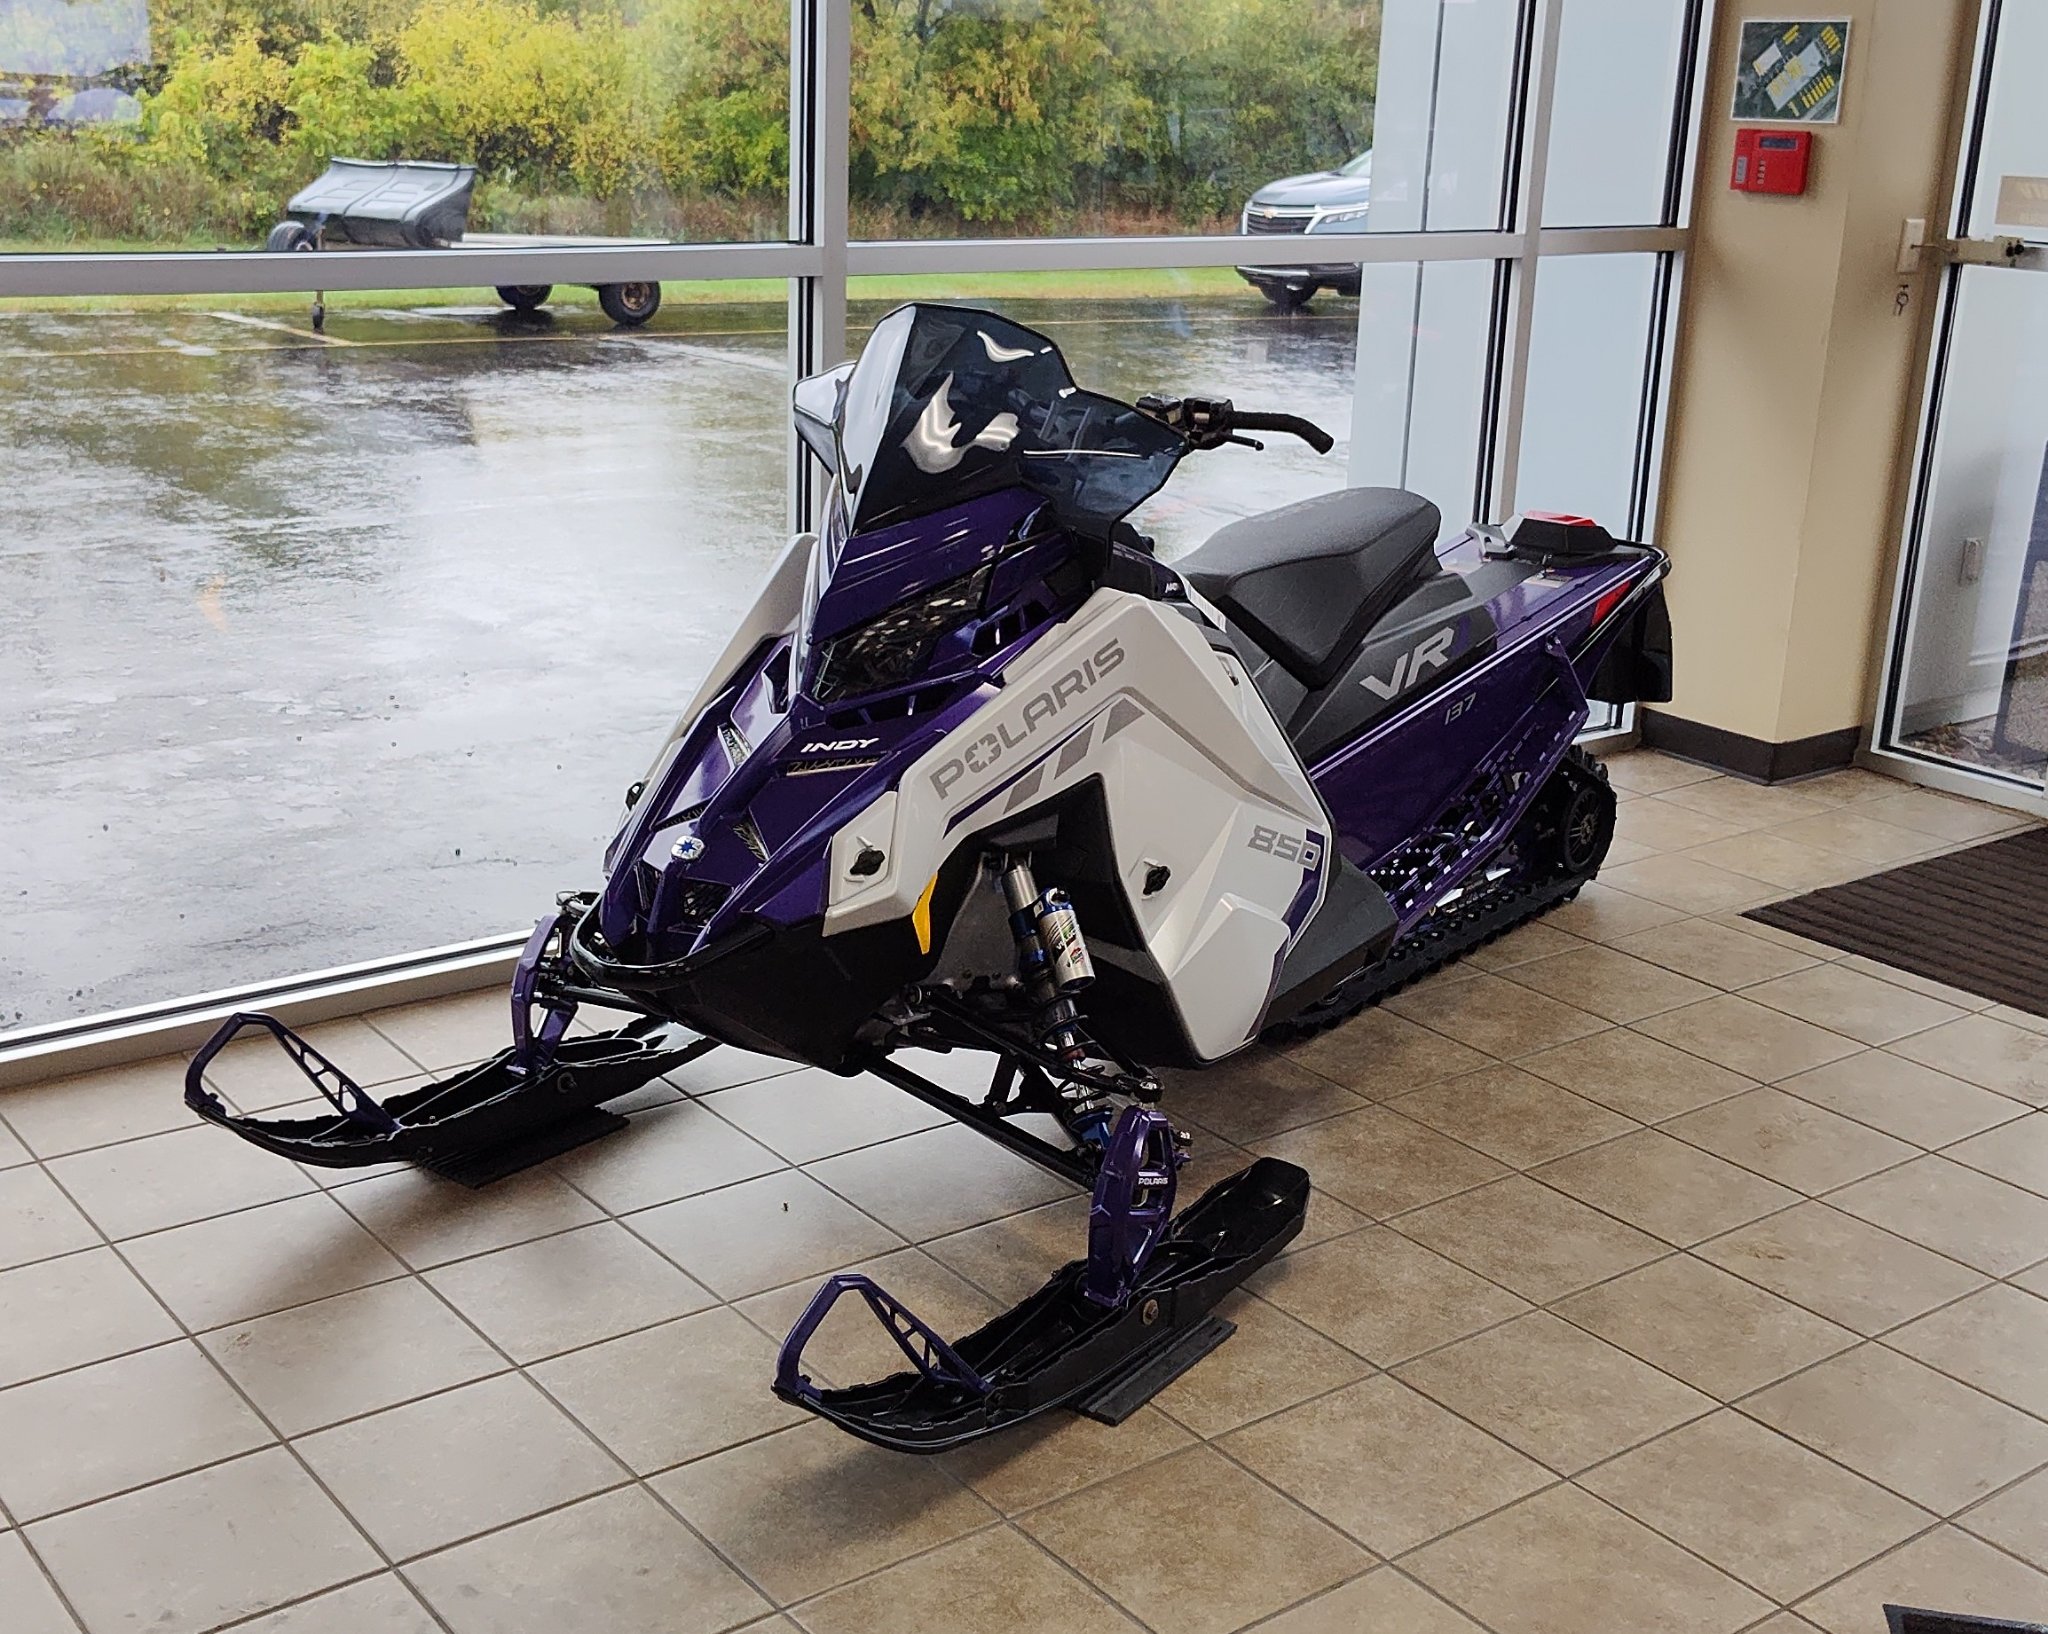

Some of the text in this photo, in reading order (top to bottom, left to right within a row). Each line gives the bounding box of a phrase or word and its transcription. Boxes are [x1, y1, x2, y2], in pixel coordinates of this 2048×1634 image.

[1359, 626, 1455, 700] VR
[929, 638, 1125, 800] POLARIS
[1445, 692, 1477, 726] 137
[801, 738, 880, 753] INDY
[1248, 825, 1321, 871] 850
[1138, 1177, 1168, 1185] POLARIS
